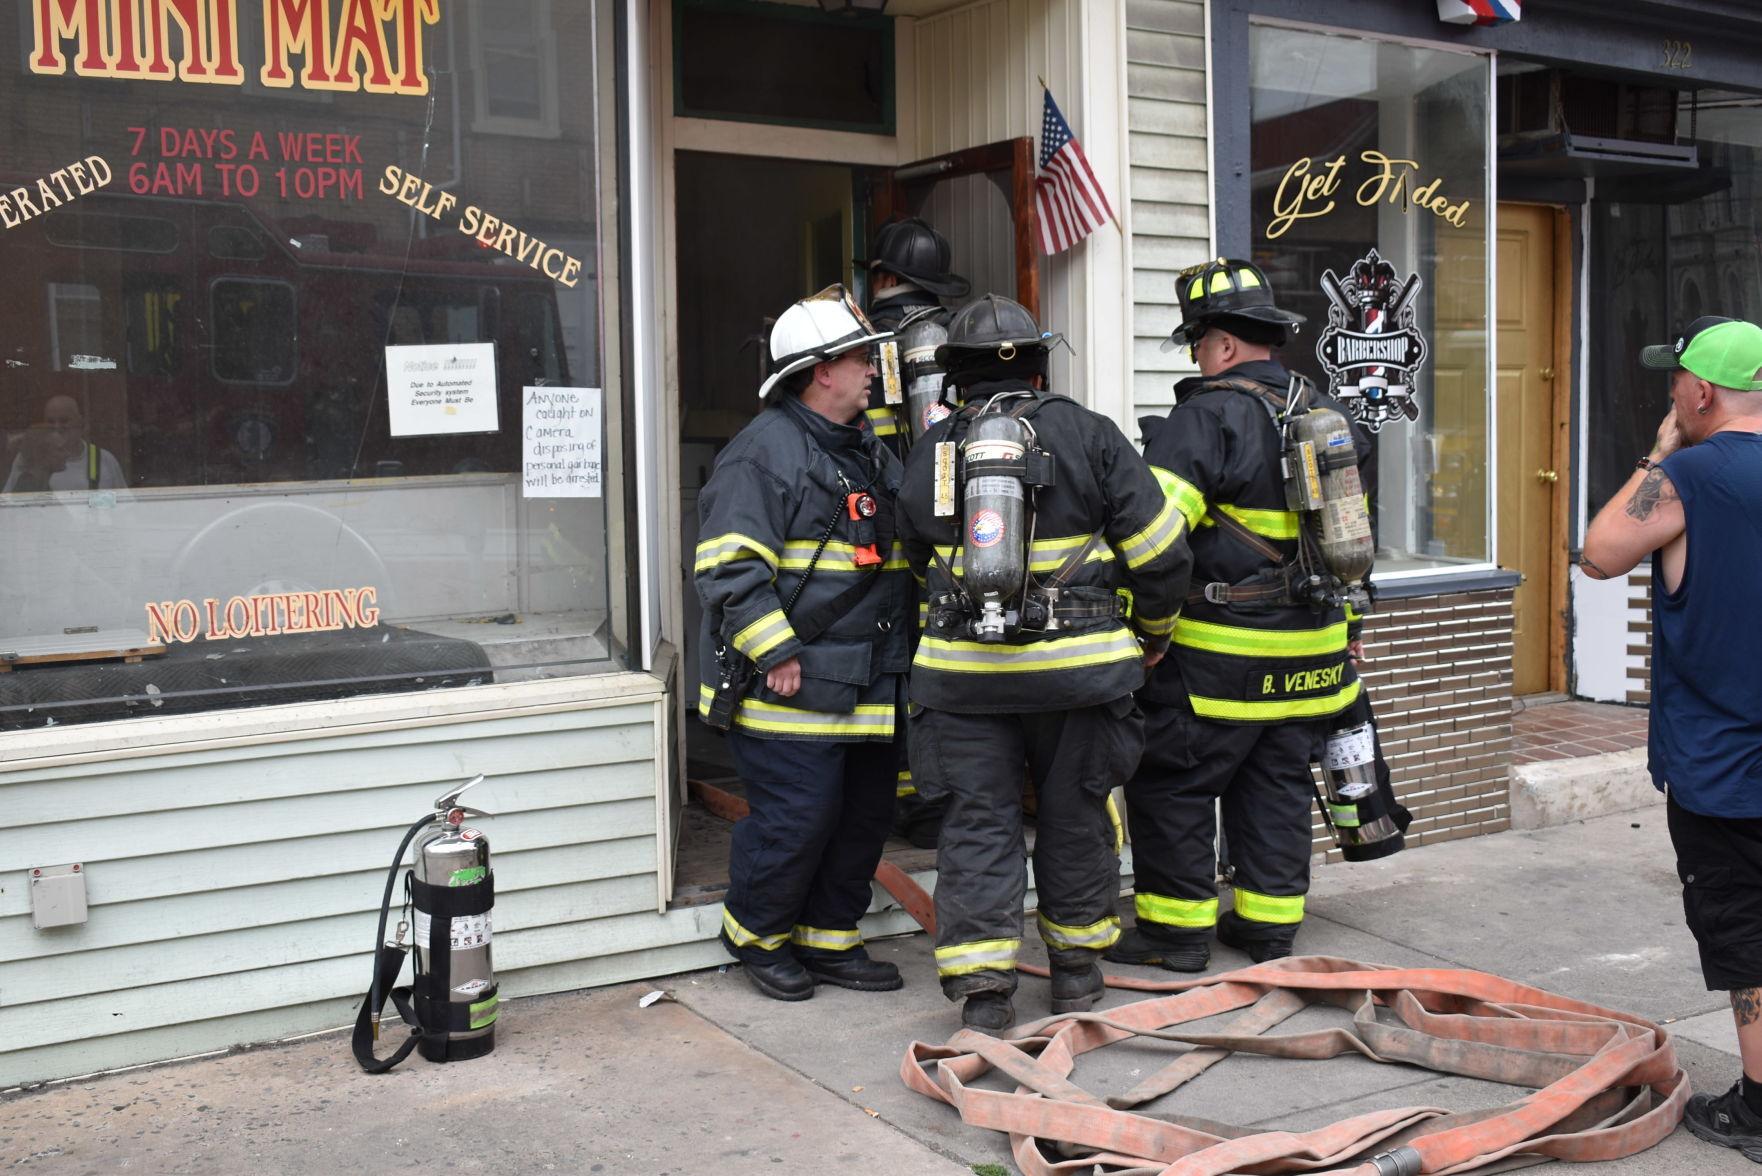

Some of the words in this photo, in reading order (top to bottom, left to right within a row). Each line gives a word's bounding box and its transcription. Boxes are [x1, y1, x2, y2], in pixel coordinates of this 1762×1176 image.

[29, 0, 244, 85] MINI
[260, 0, 440, 96] MAT
[1663, 40, 1696, 69] 322
[128, 127, 146, 156] 7
[160, 127, 238, 160] DAYS
[248, 131, 269, 160] A
[278, 131, 364, 164] WEEK
[0, 155, 112, 229] ERATED
[128, 162, 203, 195] 6AM
[215, 164, 260, 197] TO
[275, 166, 365, 200] 10PM
[1266, 155, 1346, 239] Get
[379, 165, 456, 220] SELF
[459, 206, 581, 288] SERVICE
[1336, 336, 1409, 364] BARBERSHOP
[445, 389, 469, 397] system
[586, 440, 597, 450] of
[526, 458, 566, 477] personal
[526, 474, 548, 487] will
[551, 473, 564, 485] be
[145, 599, 200, 643] NO
[204, 586, 380, 640] LOITERING
[1262, 674, 1276, 694] B.
[1284, 662, 1345, 692] VENESKY
